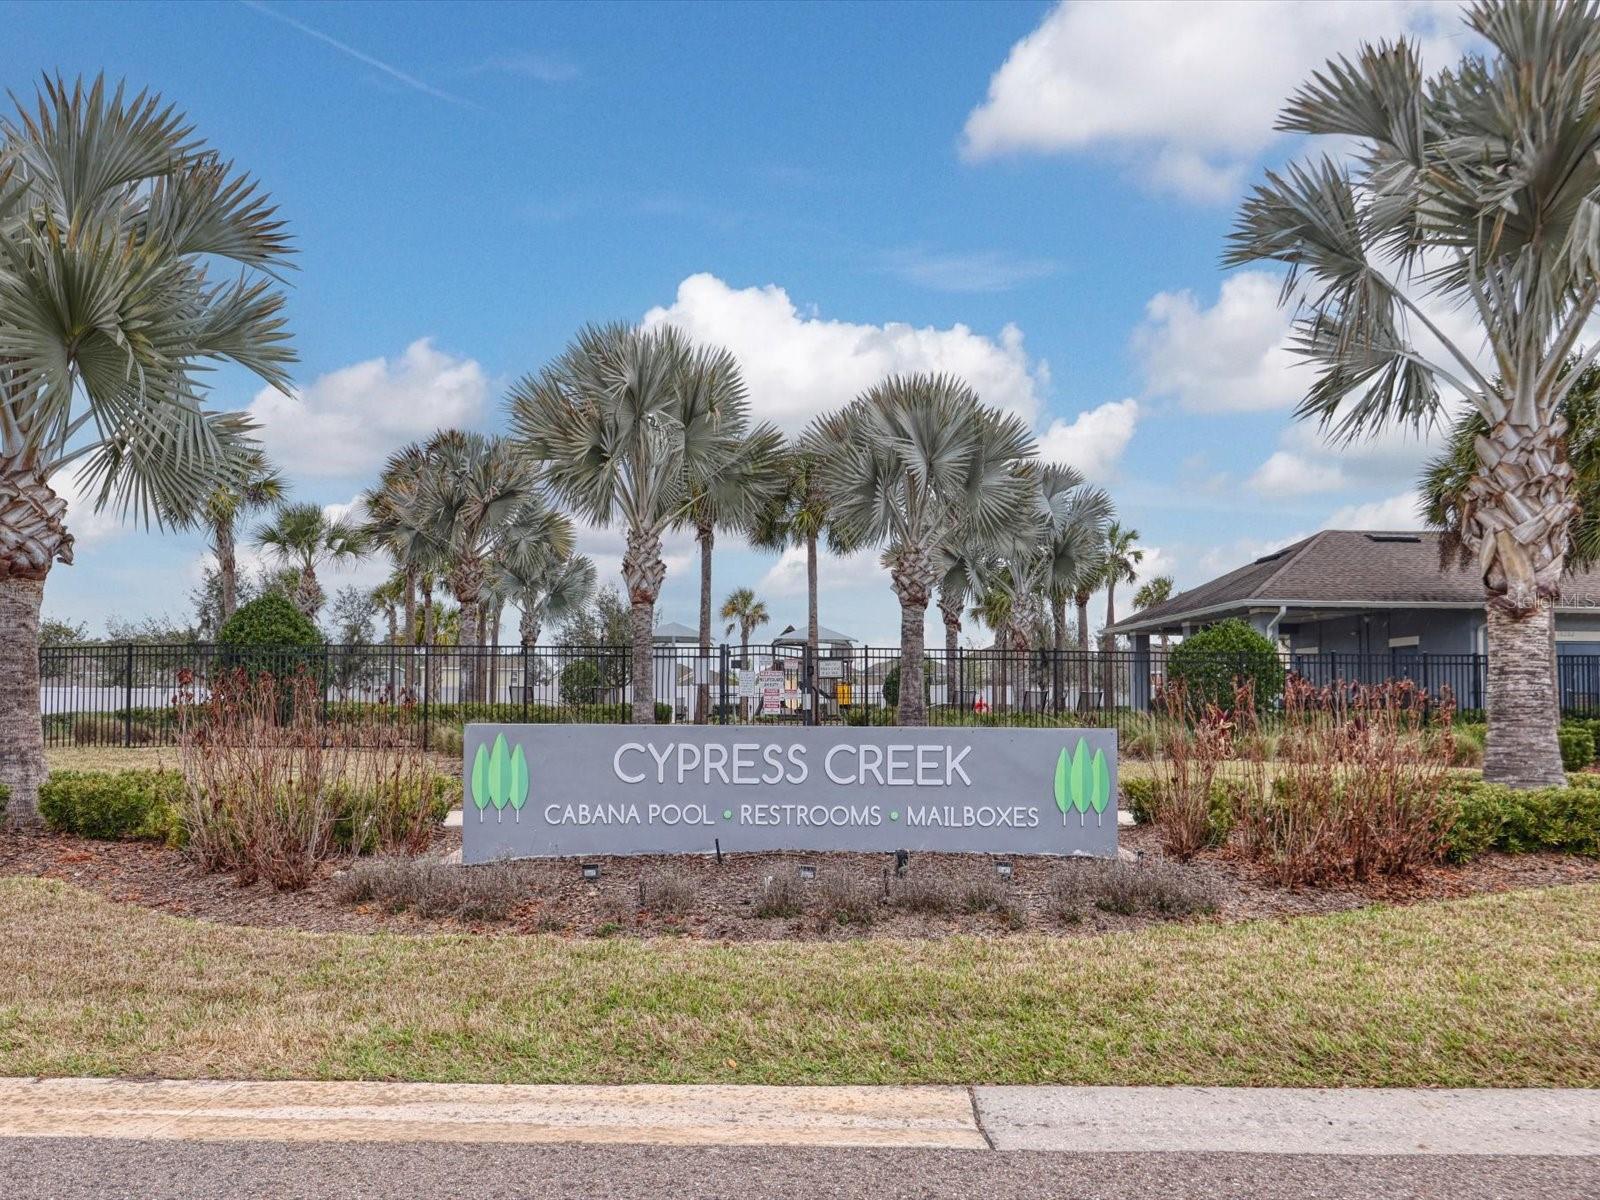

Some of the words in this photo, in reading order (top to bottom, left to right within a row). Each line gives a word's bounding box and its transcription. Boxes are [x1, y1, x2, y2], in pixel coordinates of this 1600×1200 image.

[613, 742, 808, 784] CYPRESS
[824, 743, 972, 786] CREEK
[544, 803, 641, 825] CABANA
[648, 803, 715, 826] POOL
[740, 804, 882, 826] RESTROOMS
[907, 805, 1039, 828] MAILBOXES
